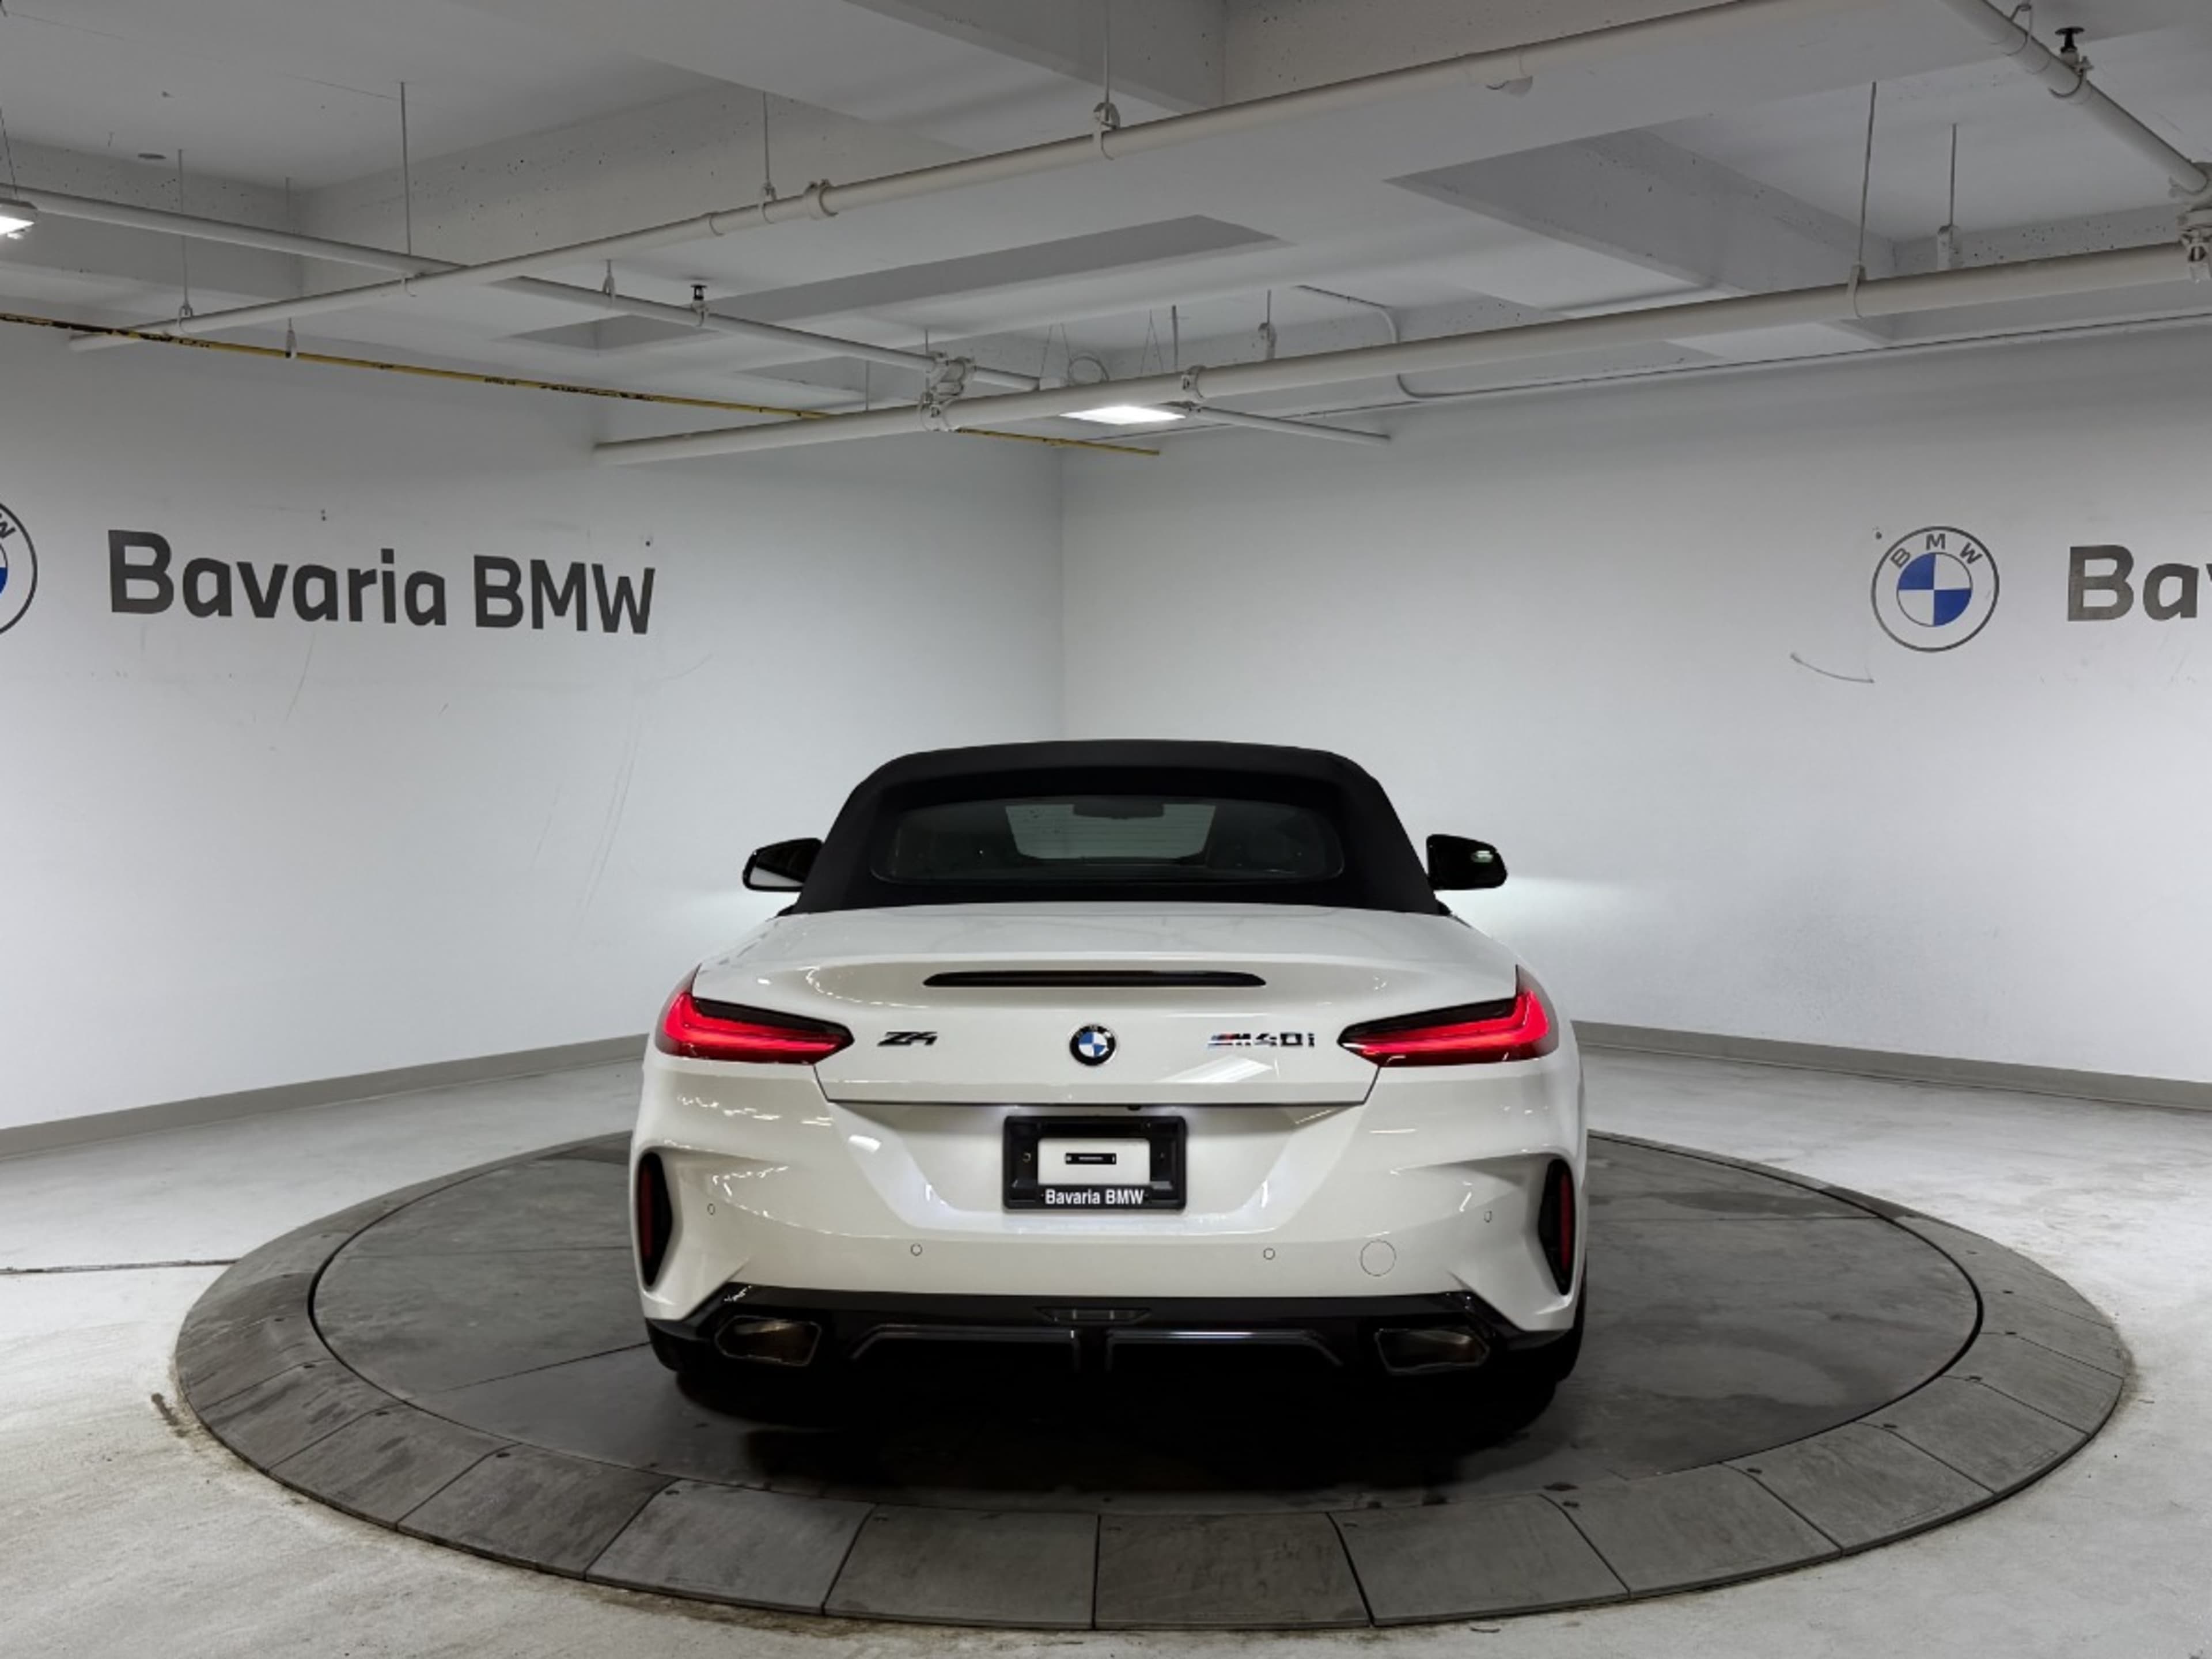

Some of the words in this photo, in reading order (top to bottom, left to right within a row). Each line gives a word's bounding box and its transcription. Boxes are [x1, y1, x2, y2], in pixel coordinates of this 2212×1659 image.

[1891, 533, 1983, 569] BMW
[108, 529, 446, 626] Bavaria
[474, 555, 656, 634] BMW
[2067, 544, 2212, 622] Ba
[877, 1031, 938, 1047] Z4
[1045, 1188, 1101, 1205] Bavaria
[1105, 1188, 1145, 1205] BMW
